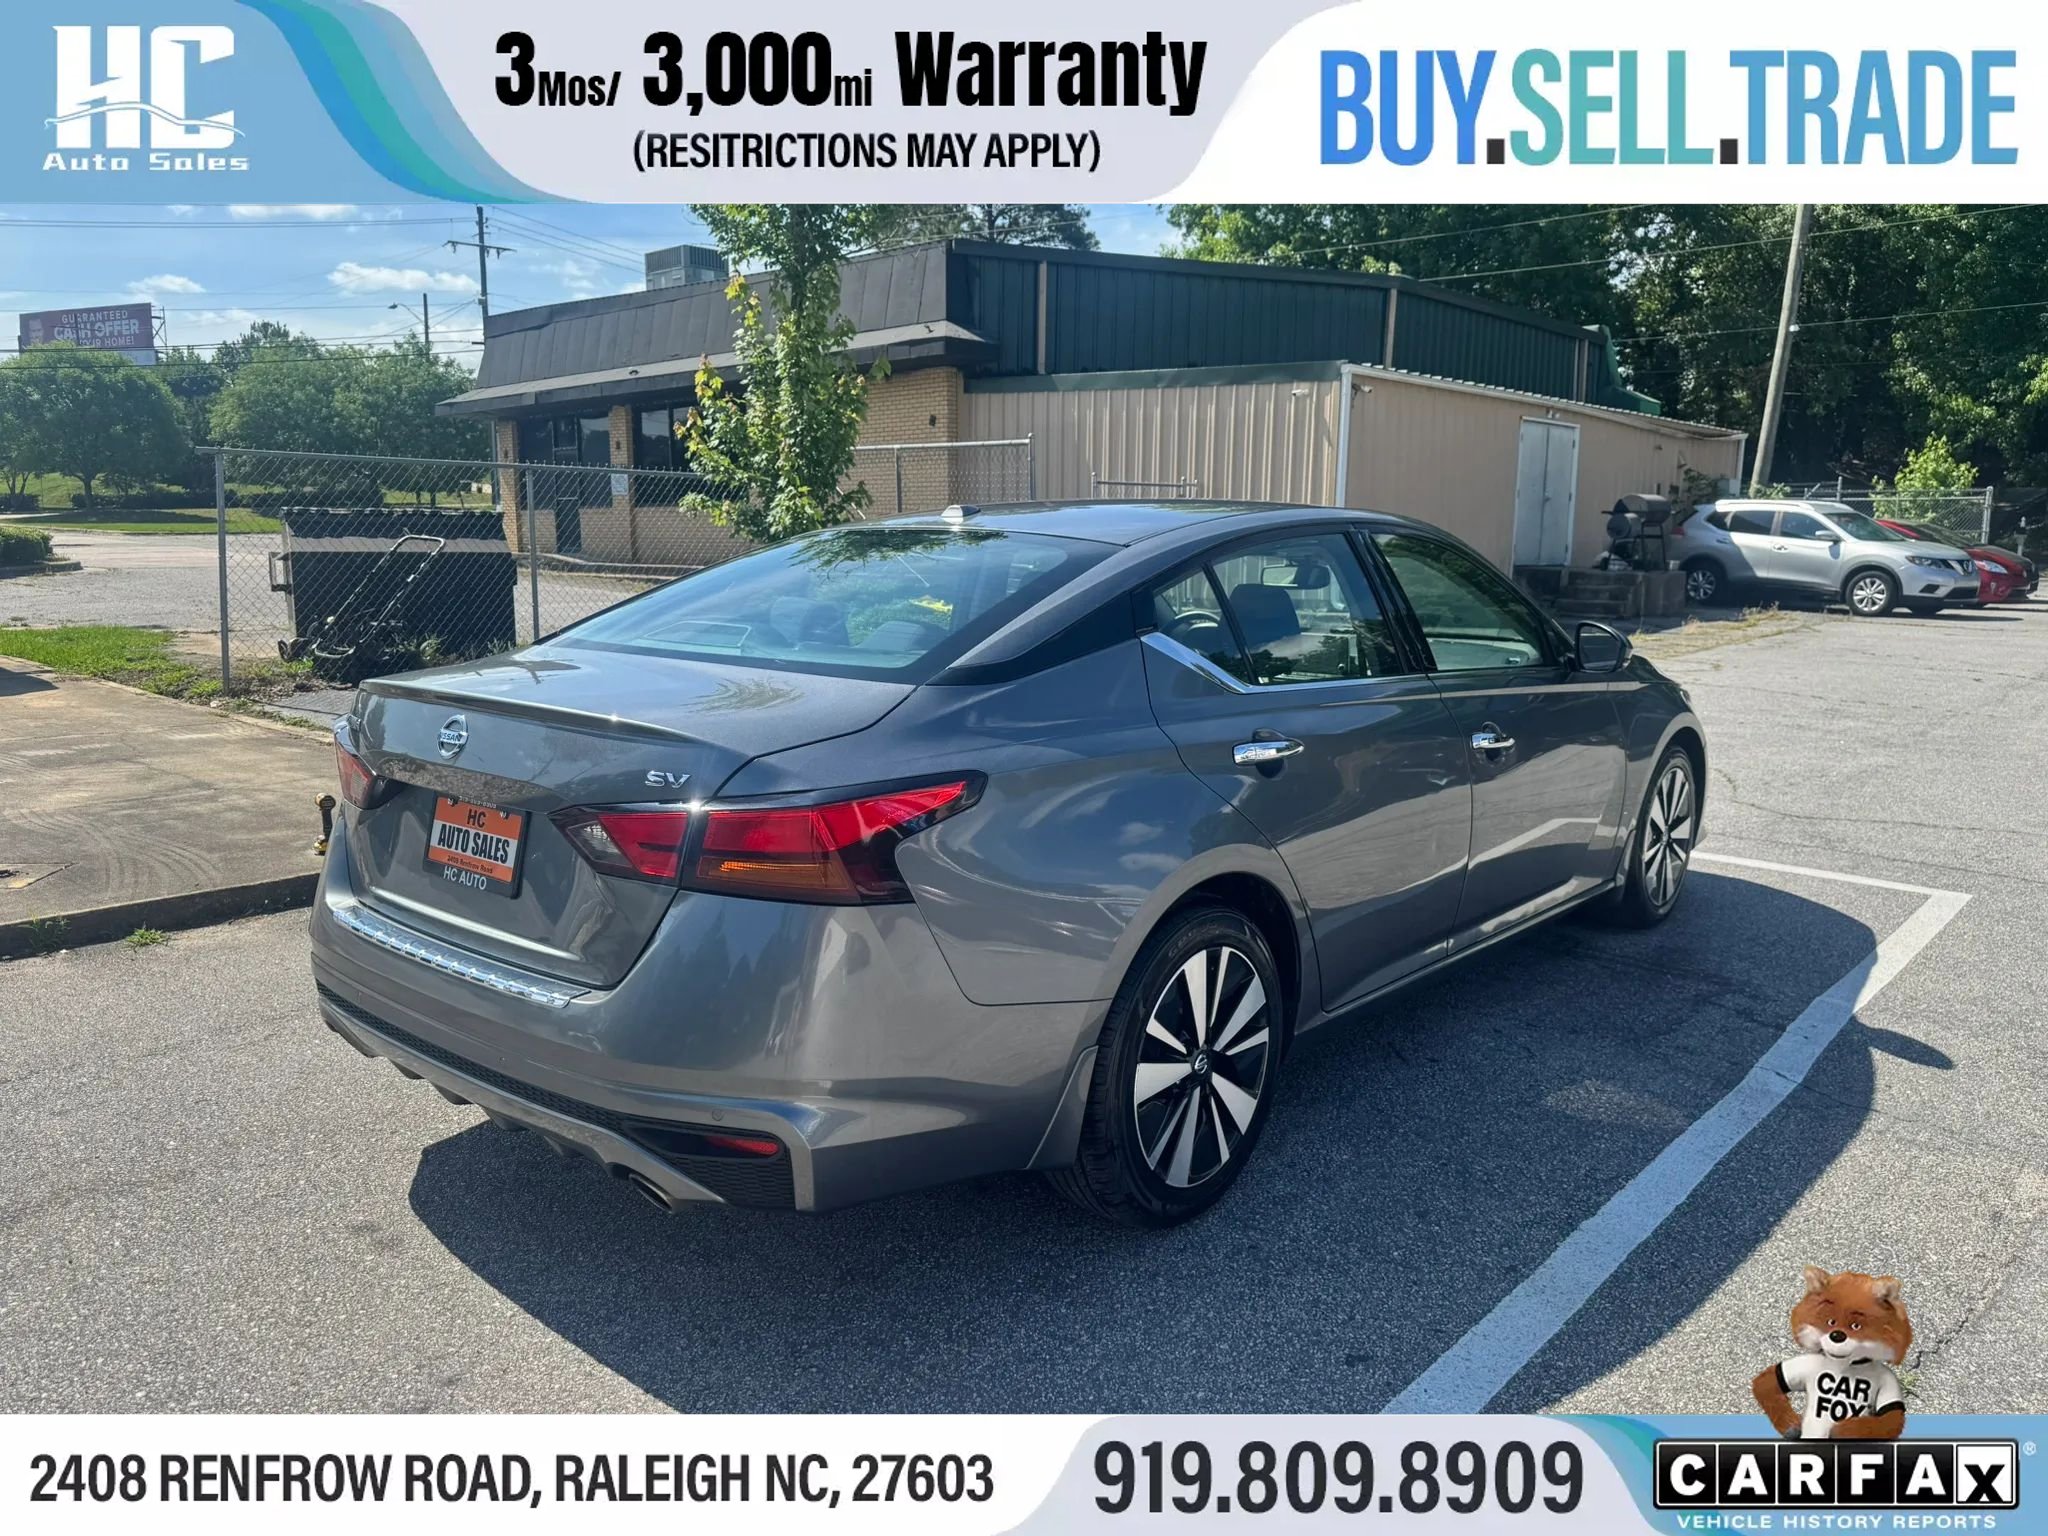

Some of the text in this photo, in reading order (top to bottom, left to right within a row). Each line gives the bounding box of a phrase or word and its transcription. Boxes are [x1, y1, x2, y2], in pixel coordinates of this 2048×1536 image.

[95, 319, 139, 337] OFFER
[104, 336, 135, 347] HOME!
[439, 732, 461, 742] SSAN
[645, 770, 690, 789] SV
[467, 808, 486, 828] HC
[437, 823, 510, 864] AUTO SALES
[443, 866, 487, 890] HC AUTO
